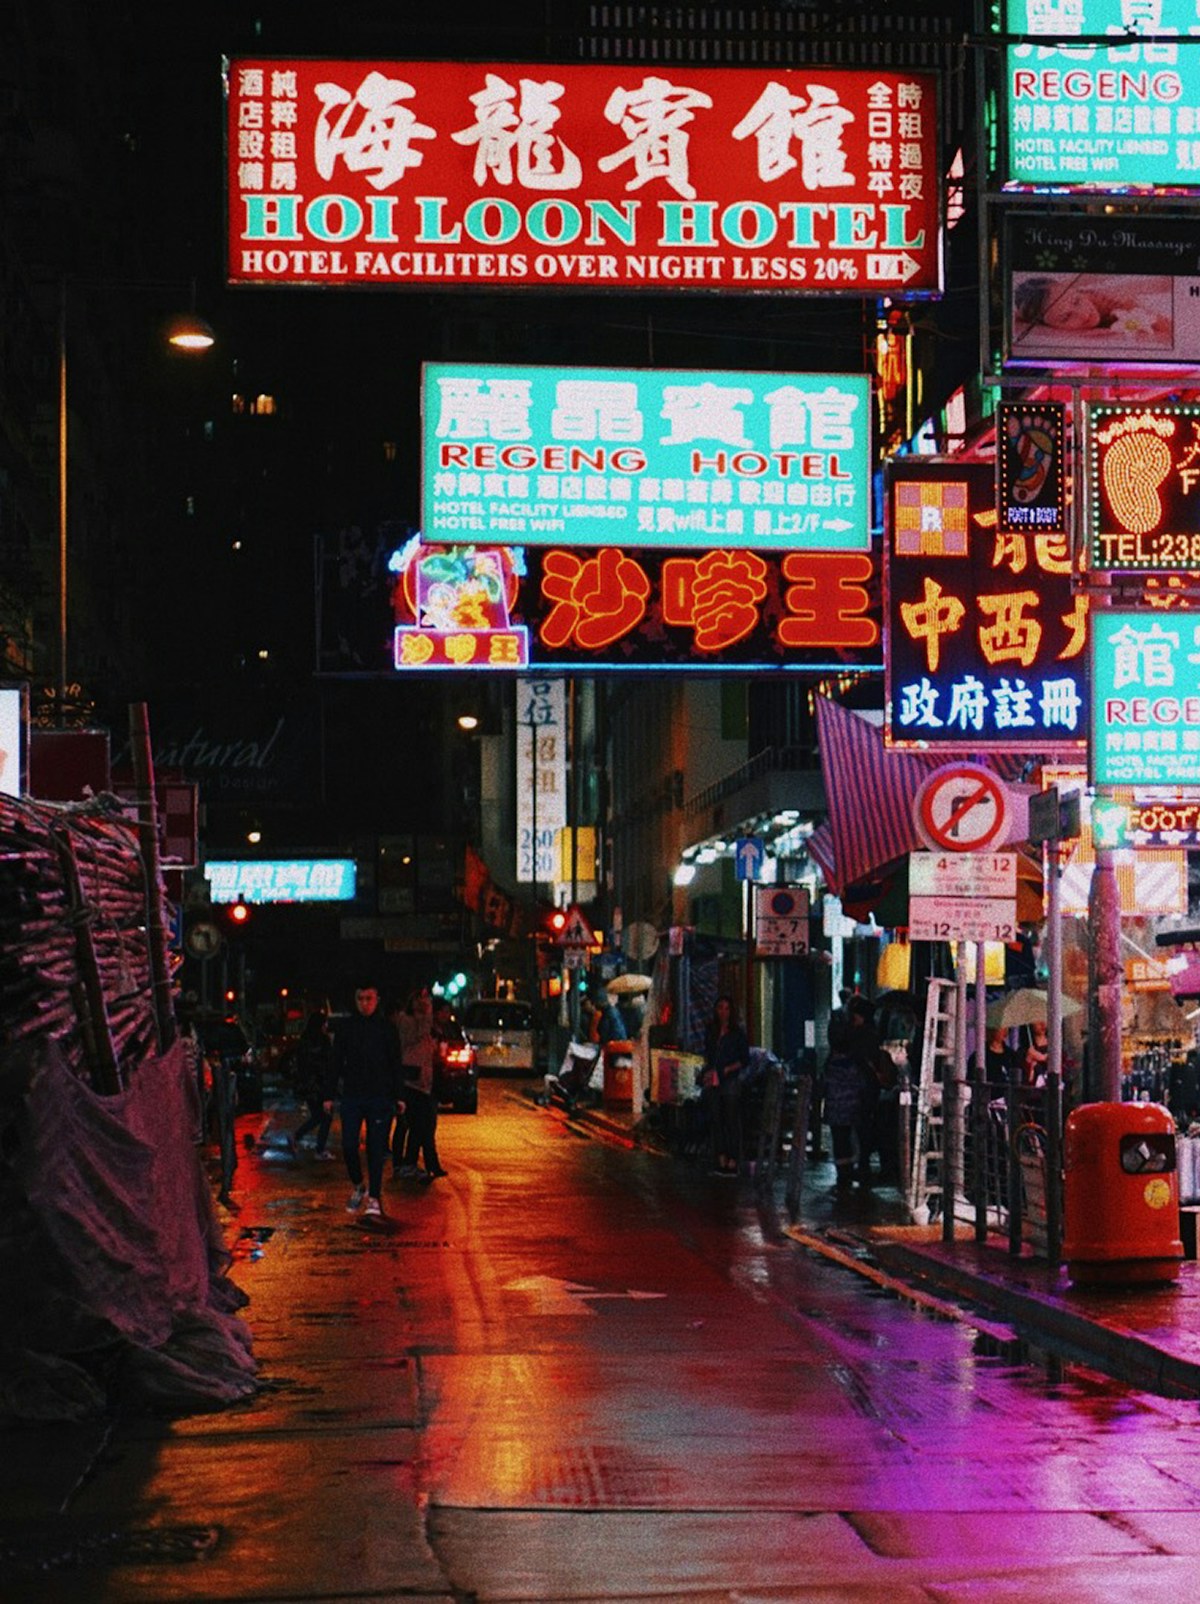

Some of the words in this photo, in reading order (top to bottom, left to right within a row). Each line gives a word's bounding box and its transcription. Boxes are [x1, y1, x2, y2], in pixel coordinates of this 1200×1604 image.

[1013, 69, 1182, 103] REGENG
[238, 69, 264, 190] 酒店設備
[314, 70, 856, 200] 海龍賓館
[867, 81, 894, 199] 全日特平
[897, 83, 924, 200] 時租過夜
[1014, 138, 1057, 153] HOTEL
[1060, 139, 1114, 155] FACILITY
[1014, 155, 1057, 171] HOTEL
[1060, 155, 1090, 171] FREE
[240, 194, 399, 243] HOI
[415, 195, 638, 247] LOON
[657, 199, 926, 250] HOTEL
[1112, 231, 1194, 255] Massage
[241, 251, 348, 275] HOTEL
[355, 253, 527, 278] FACILITEIS
[534, 255, 619, 280] OVER
[626, 255, 727, 281] NIGHT
[732, 256, 807, 281] LESS
[814, 257, 858, 281] 20%
[438, 442, 648, 474] REGENG
[690, 448, 853, 480] HOTEL
[434, 502, 486, 515] HOTEL
[490, 502, 559, 517] FACILITY
[434, 516, 486, 530] HOTEL
[490, 518, 525, 531] FREE
[899, 675, 1082, 731] 政府註冊
[1106, 766, 1162, 779] HOTEL
[1126, 808, 1192, 833] FOOT
[993, 858, 1010, 871] 12
[995, 924, 1012, 939] 12
